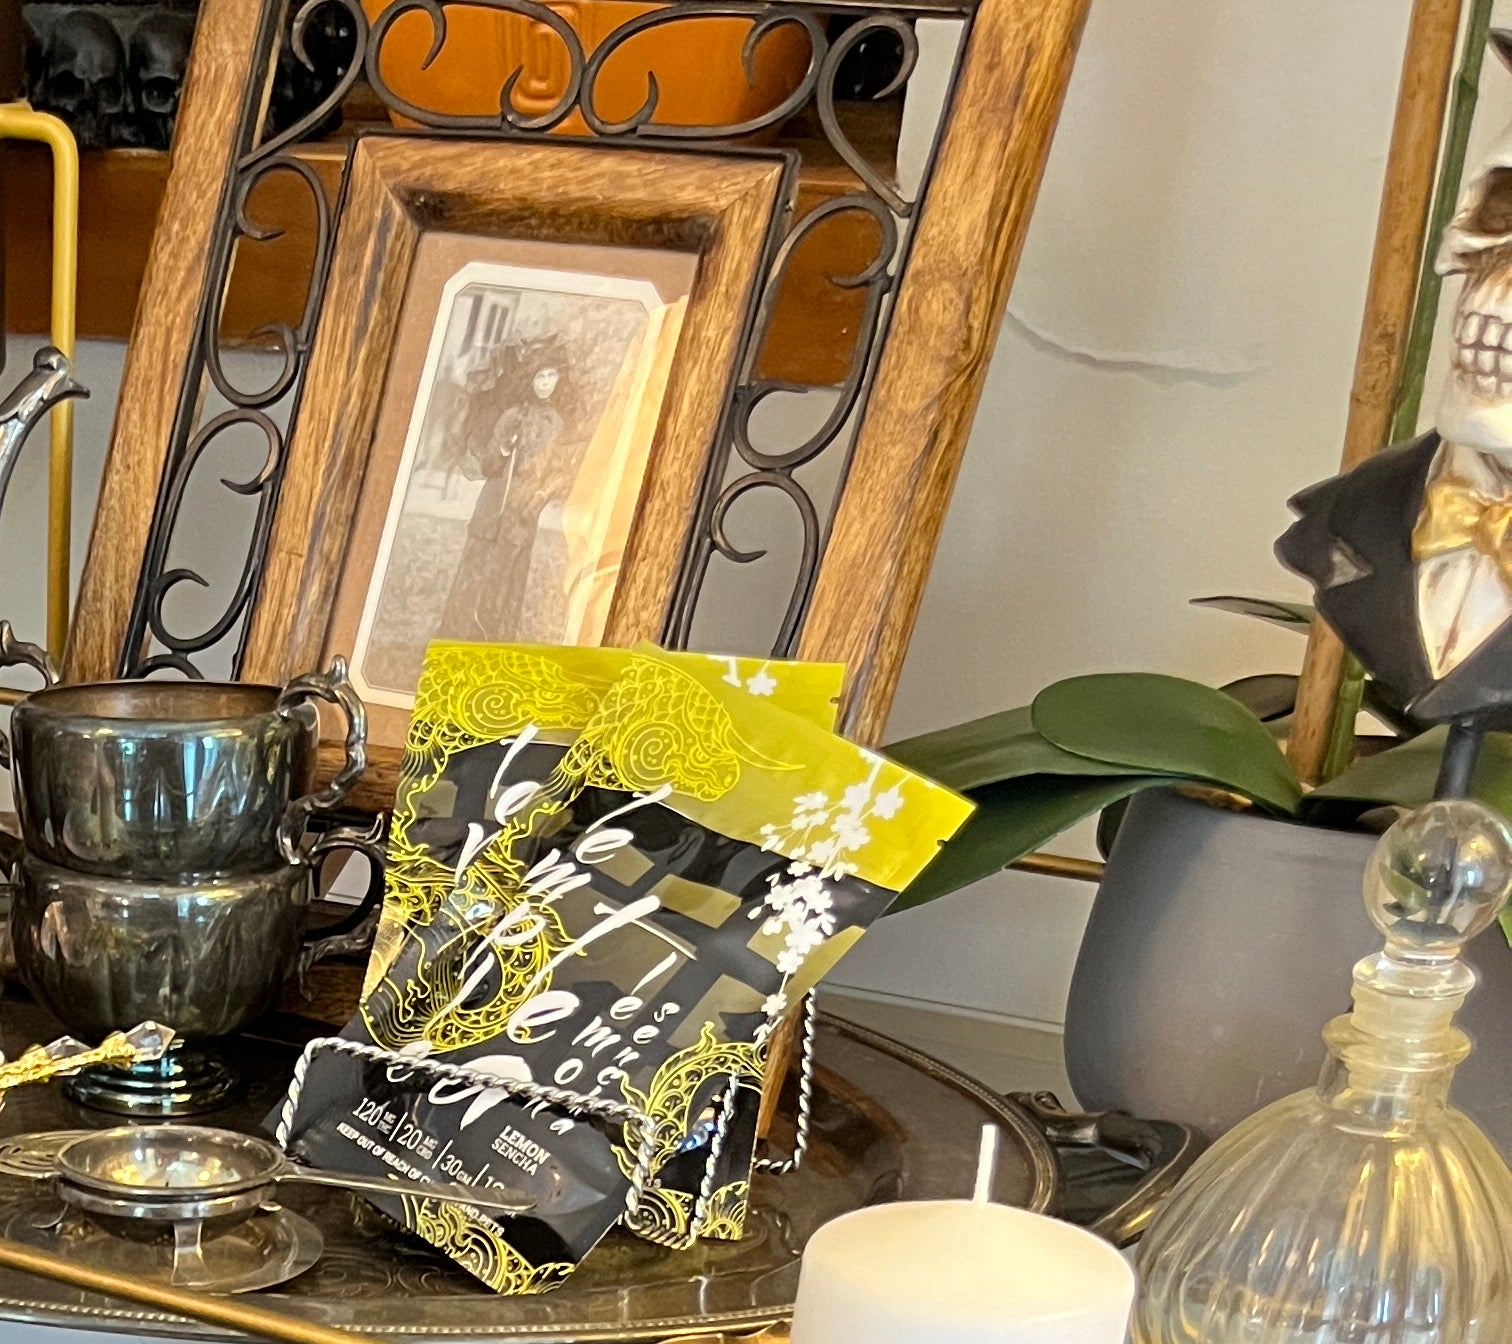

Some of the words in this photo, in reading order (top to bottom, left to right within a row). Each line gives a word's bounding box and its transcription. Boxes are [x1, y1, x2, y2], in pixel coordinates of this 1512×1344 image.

[352, 1097, 383, 1126] 120
[396, 1123, 423, 1150] 20
[356, 1135, 376, 1151] OUT
[491, 1138, 538, 1176] SENCHA
[499, 1125, 551, 1165] LEMON
